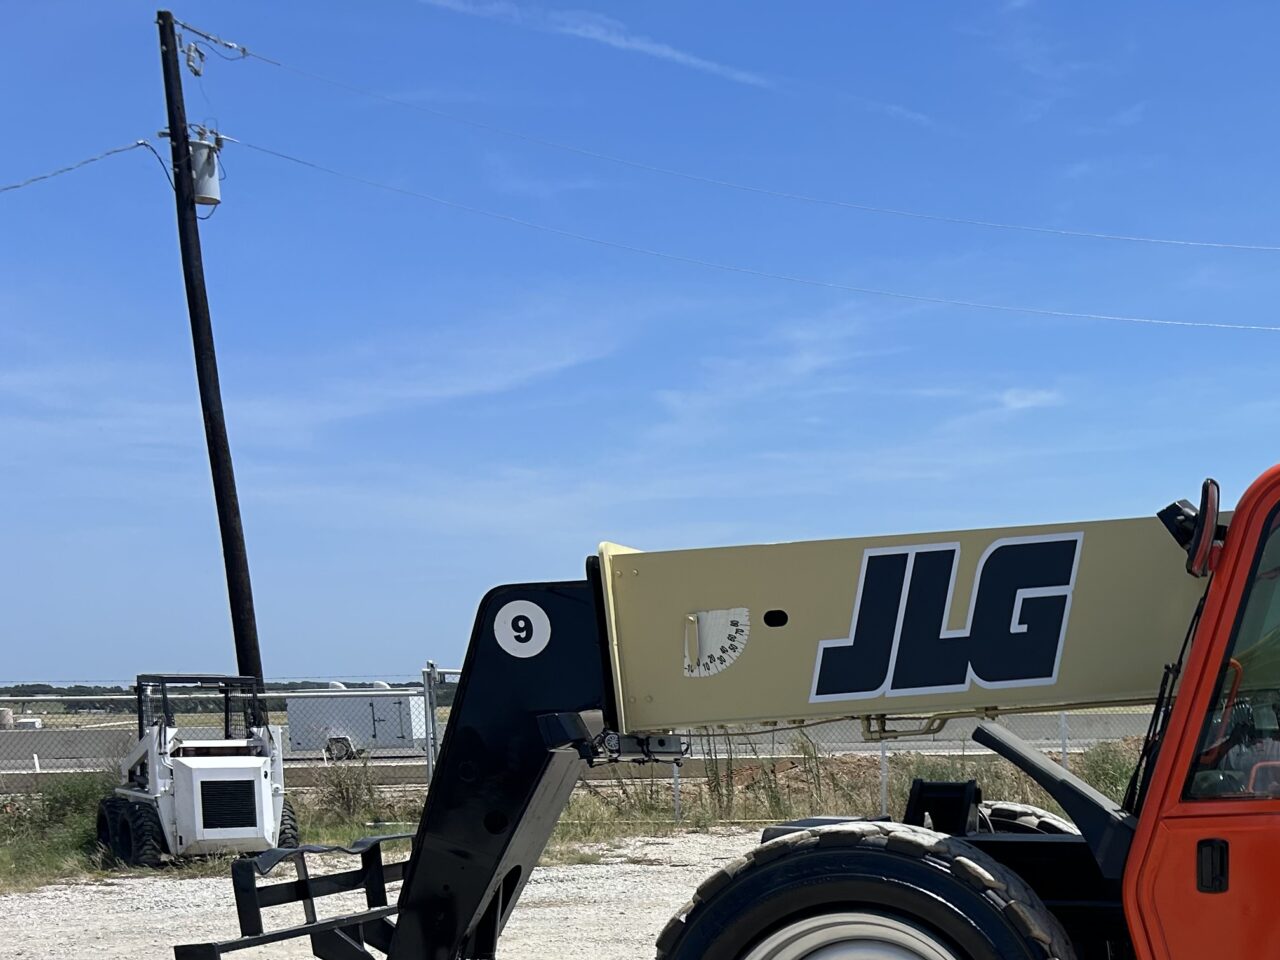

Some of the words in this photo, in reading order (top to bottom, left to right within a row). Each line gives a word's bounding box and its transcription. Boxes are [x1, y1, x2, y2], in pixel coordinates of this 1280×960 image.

[511, 614, 534, 644] 9
[809, 531, 1084, 703] JLG
[702, 662, 710, 671] 10
[707, 654, 716, 663] 20
[717, 655, 726, 665] 30
